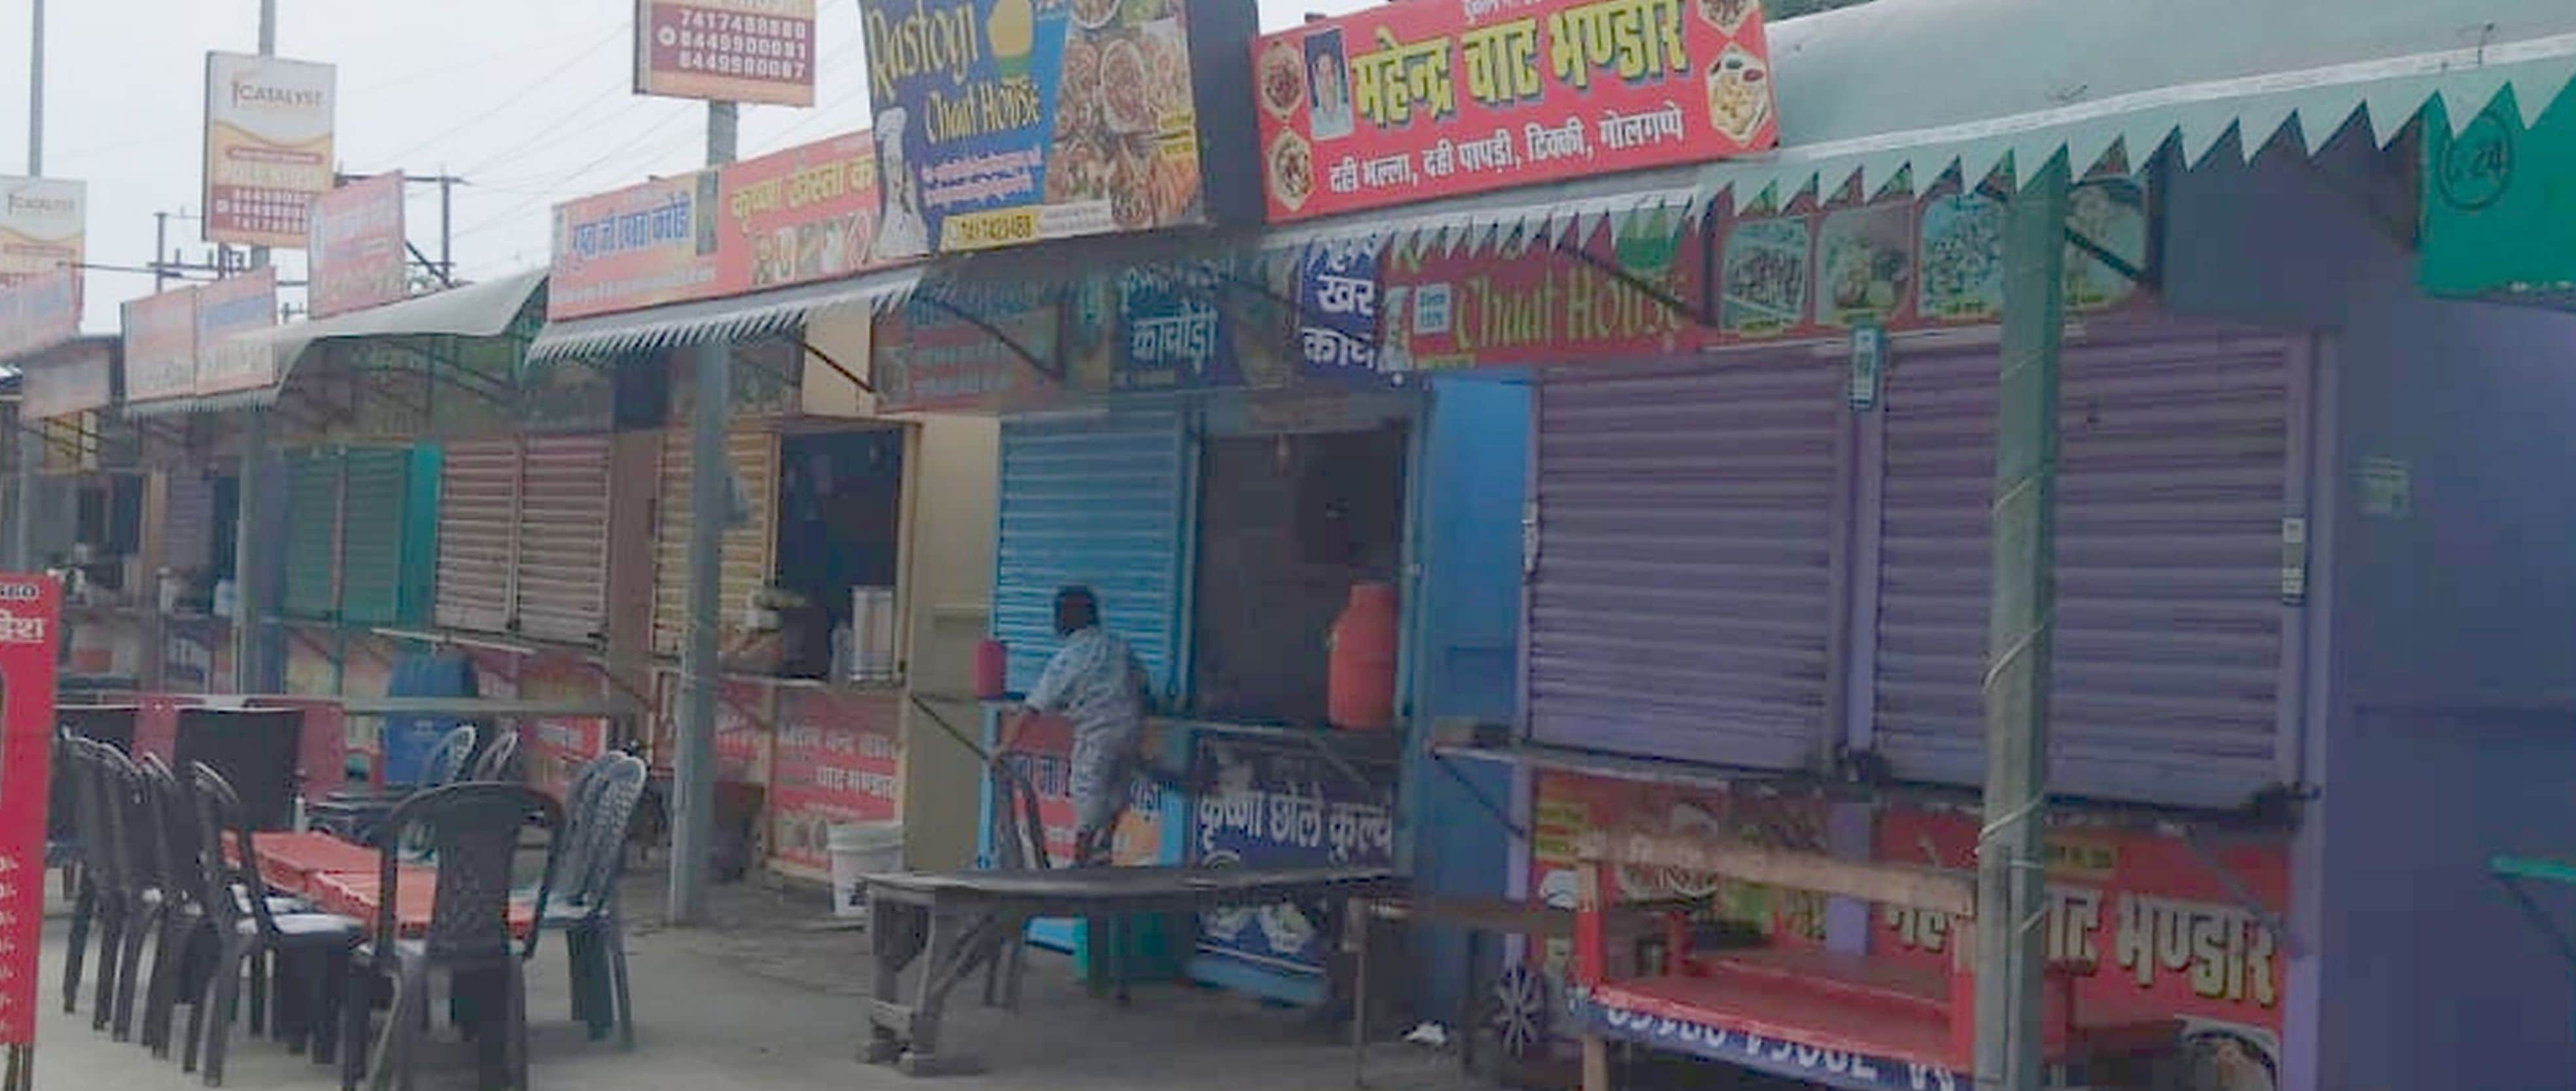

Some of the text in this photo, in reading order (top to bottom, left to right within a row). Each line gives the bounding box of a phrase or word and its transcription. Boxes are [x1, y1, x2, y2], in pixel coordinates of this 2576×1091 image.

[1351, 0, 1689, 128] महेन्द्र चाट भण्डार
[1330, 155, 1359, 192] दही
[1422, 137, 1454, 177] दही
[2114, 889, 2277, 1010] भण्डार
